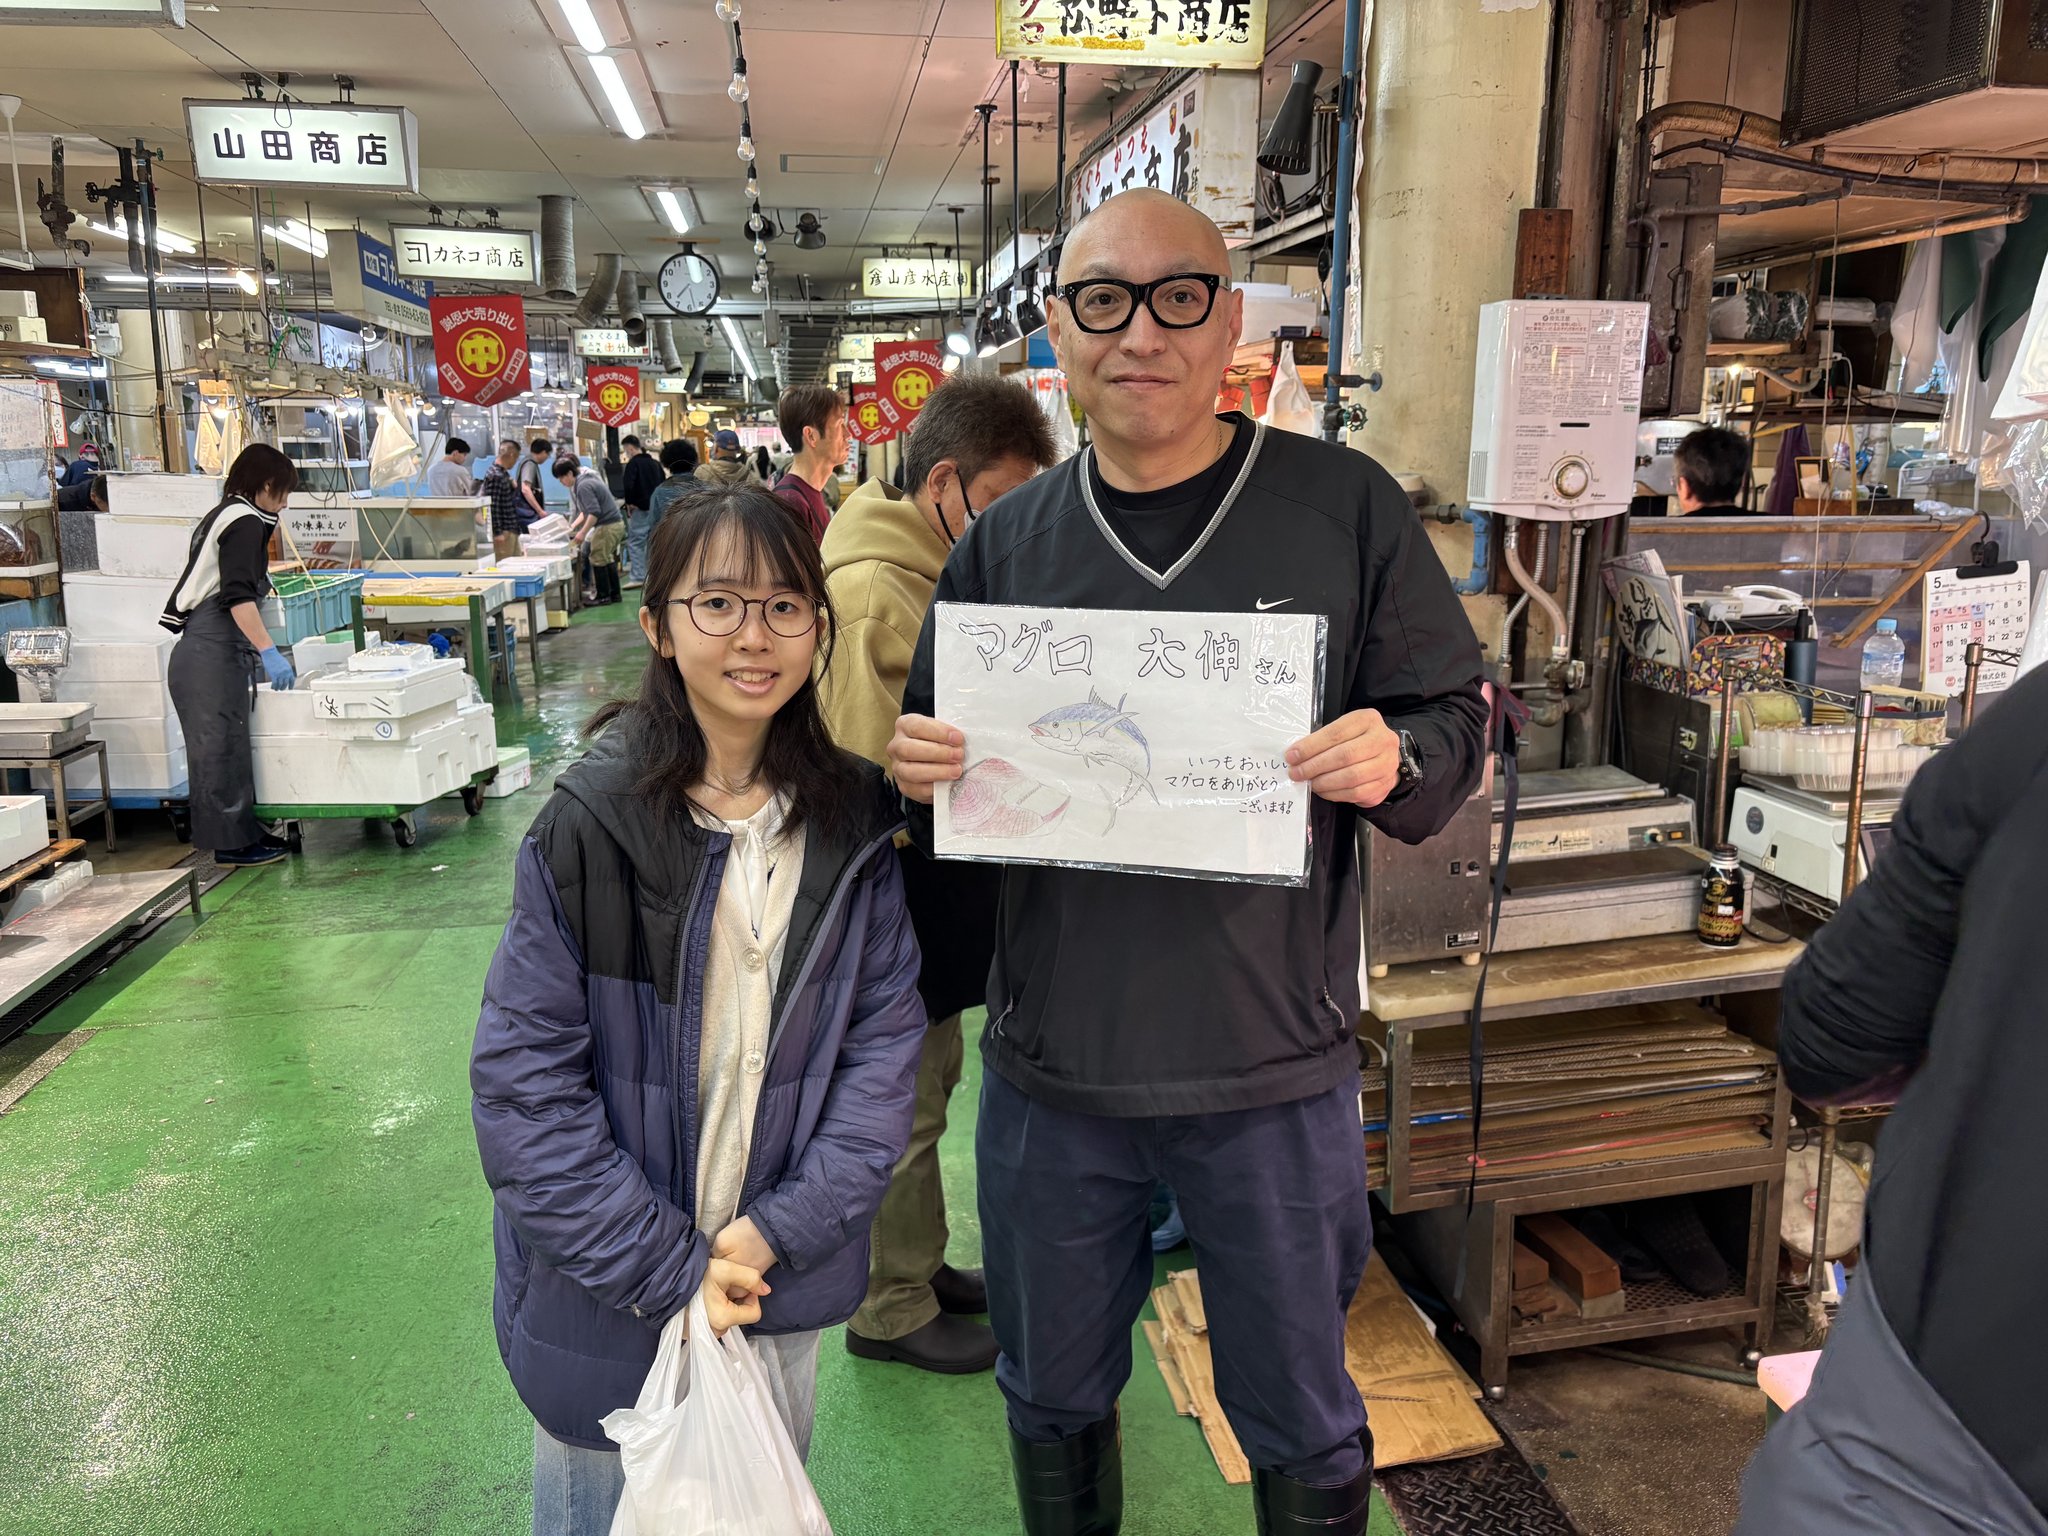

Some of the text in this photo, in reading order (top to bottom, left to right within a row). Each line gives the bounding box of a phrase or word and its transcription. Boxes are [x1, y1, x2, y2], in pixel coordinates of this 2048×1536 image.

[213, 127, 387, 165] 山田商店
[433, 246, 524, 268] カネコ商店
[439, 306, 518, 333] 謝恩大売り出し
[292, 521, 347, 532] 冷凍車えび
[1934, 577, 1942, 588] 5
[1960, 622, 1968, 630] 12
[959, 619, 1297, 685] マグロ 大伸 さん
[1960, 638, 1968, 646] 19
[1164, 772, 1279, 792] マグロをありがとう
